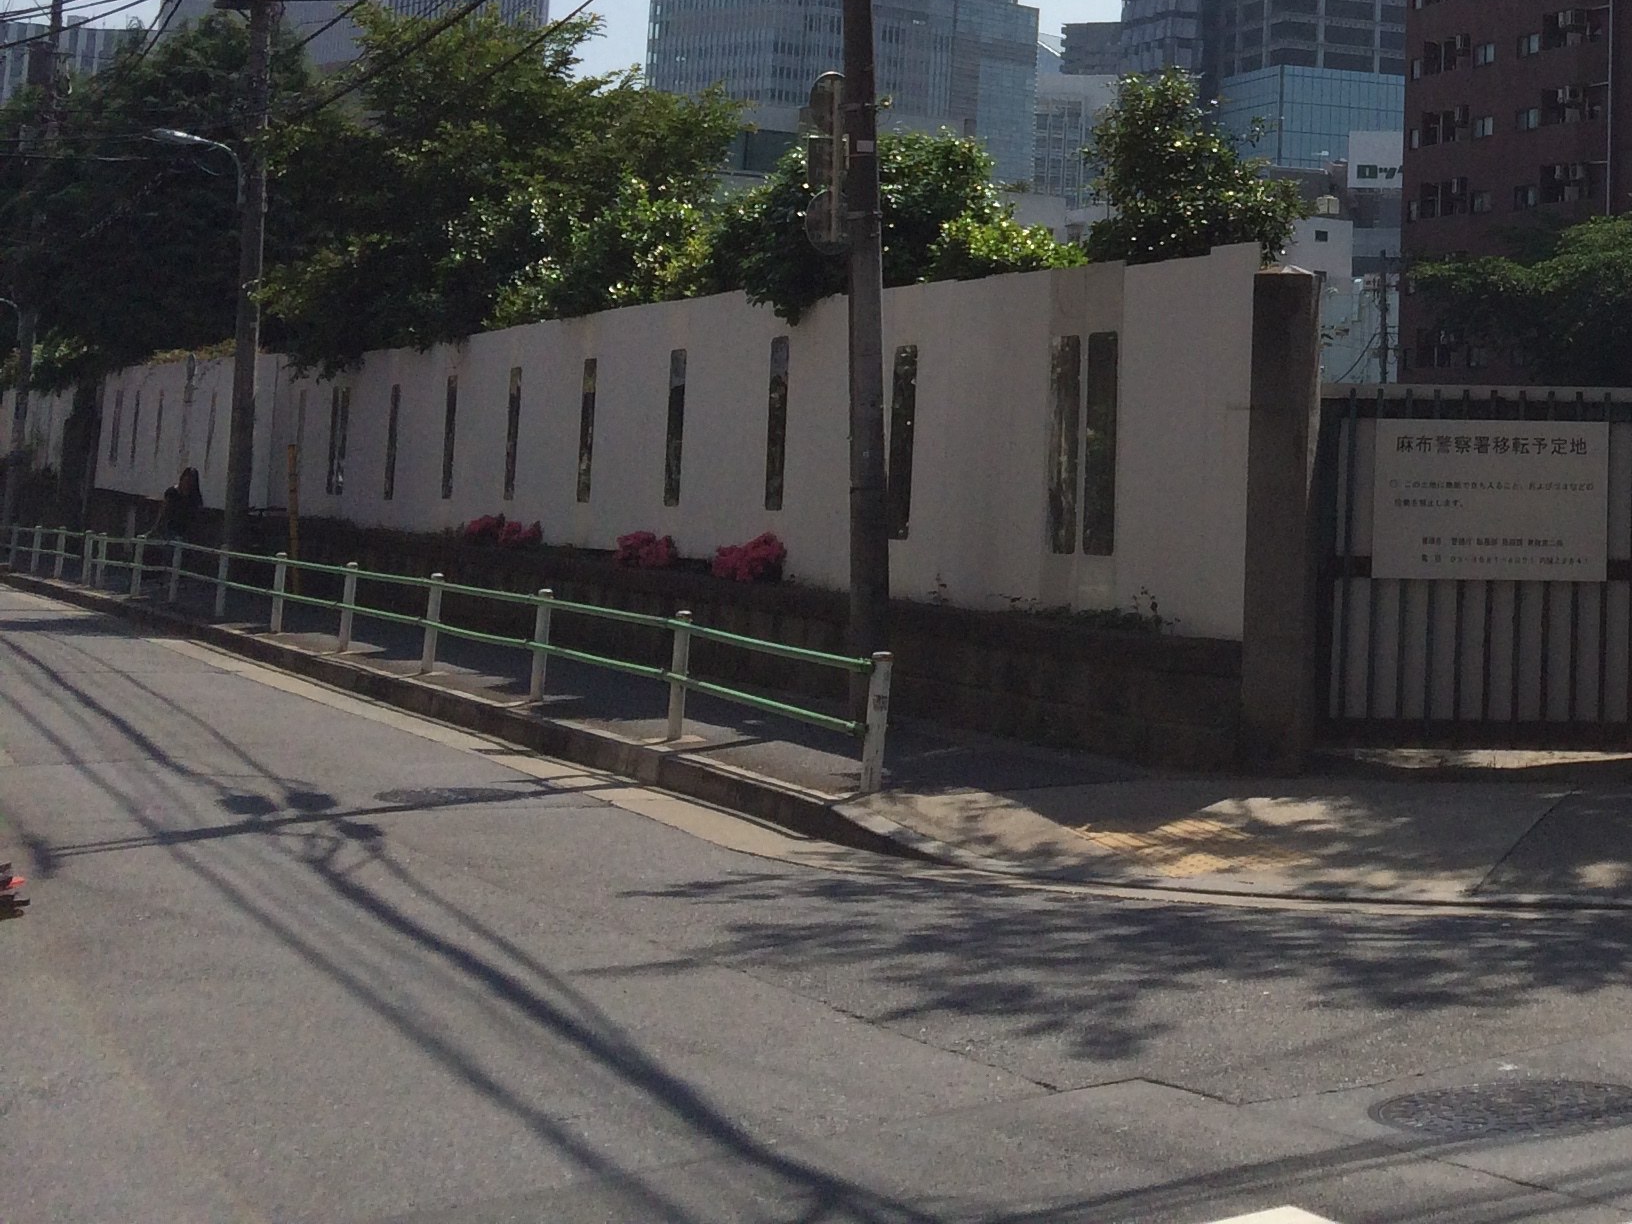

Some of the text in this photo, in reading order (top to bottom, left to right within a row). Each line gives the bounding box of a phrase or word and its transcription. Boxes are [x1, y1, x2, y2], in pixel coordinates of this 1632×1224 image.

[1396, 435, 1588, 456] 麻布警察署移転予定地
